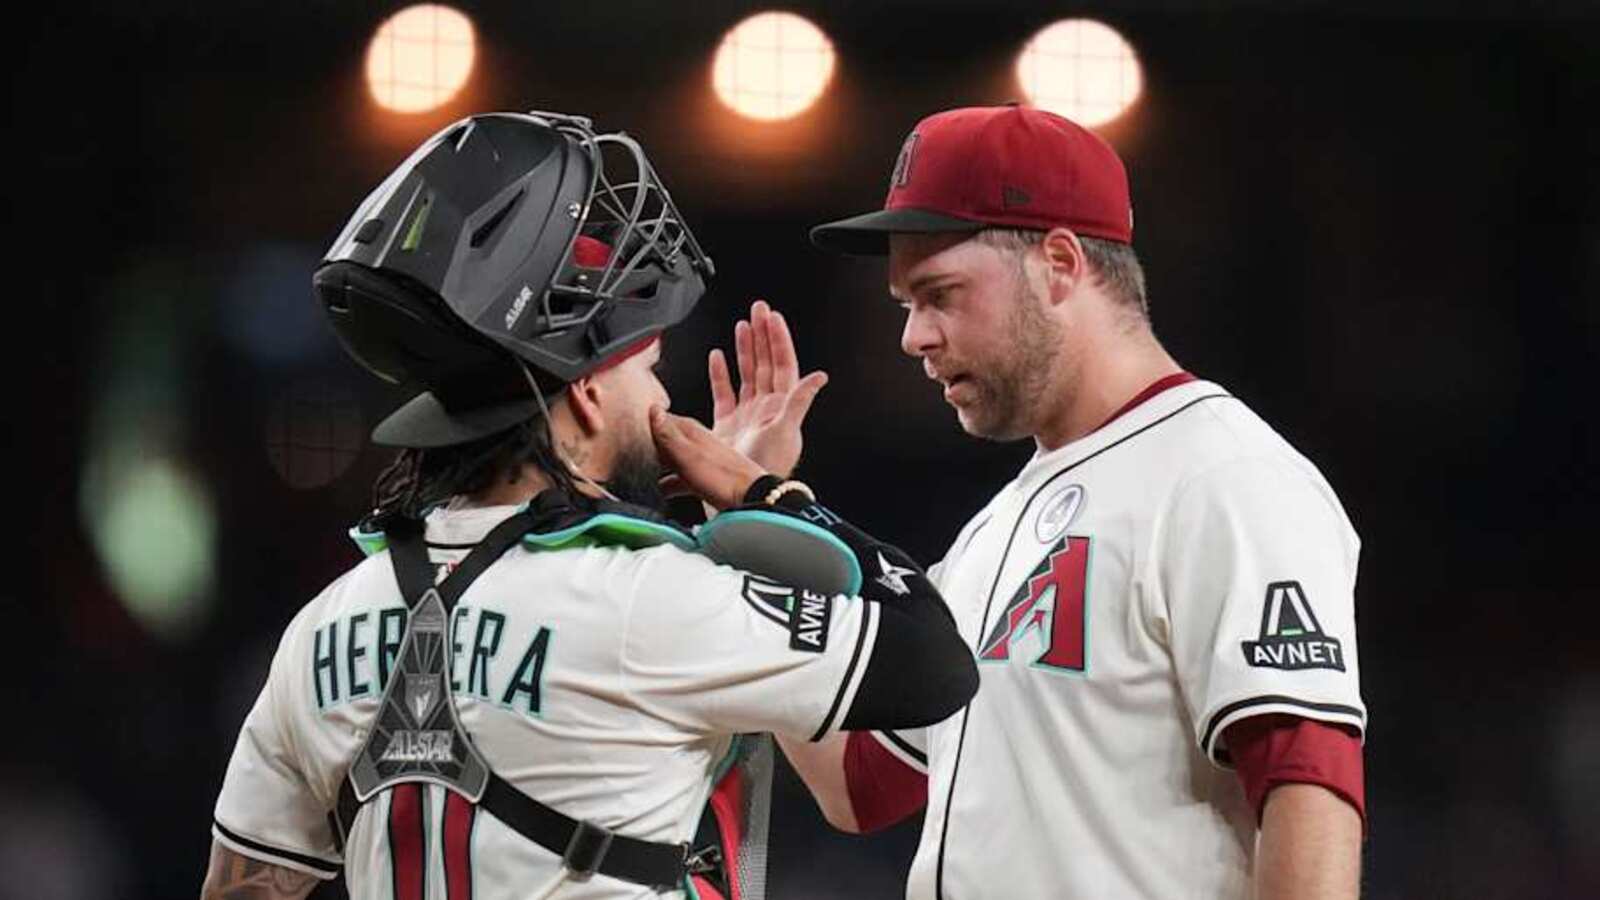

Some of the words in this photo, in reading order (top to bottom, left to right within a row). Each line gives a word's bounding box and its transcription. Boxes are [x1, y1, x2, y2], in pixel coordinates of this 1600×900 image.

[798, 589, 827, 647] AVNE
[312, 606, 552, 714] HERERA
[1253, 641, 1340, 669] AVNET
